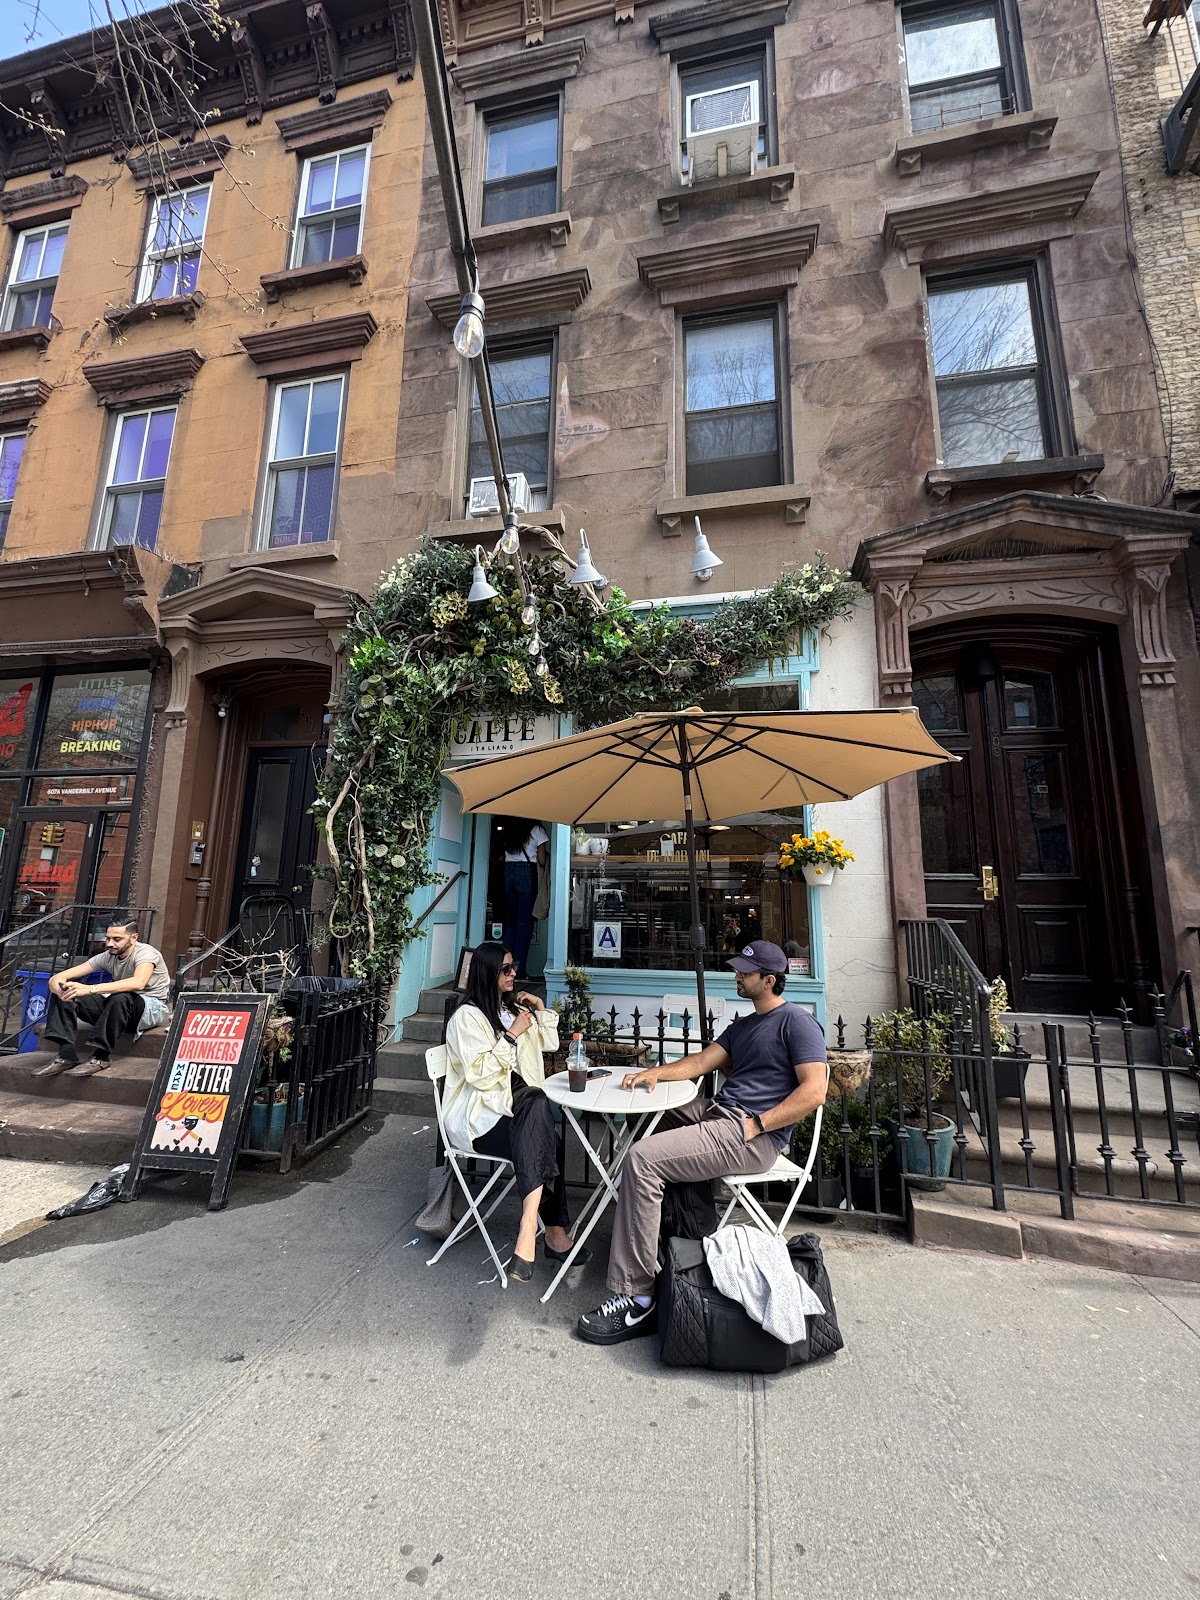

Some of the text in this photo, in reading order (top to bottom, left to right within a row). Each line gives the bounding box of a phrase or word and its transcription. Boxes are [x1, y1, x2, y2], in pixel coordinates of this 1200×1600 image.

[79, 677, 125, 689] LITTLES
[71, 719, 117, 732] HIPHOP
[454, 717, 536, 745] CAFFE
[60, 740, 121, 753] BREAKING
[470, 744, 514, 752] ITALIANO
[61, 787, 94, 795] VANDERBILT
[94, 786, 118, 794] AVENUE
[646, 849, 710, 862] DE MARINI
[598, 926, 616, 947] A
[188, 1013, 242, 1037] COFFEE
[177, 1039, 239, 1062] DRINKERS
[170, 1063, 186, 1091] MAKE
[184, 1064, 233, 1093] BETTER
[155, 1090, 227, 1124] Lovers
